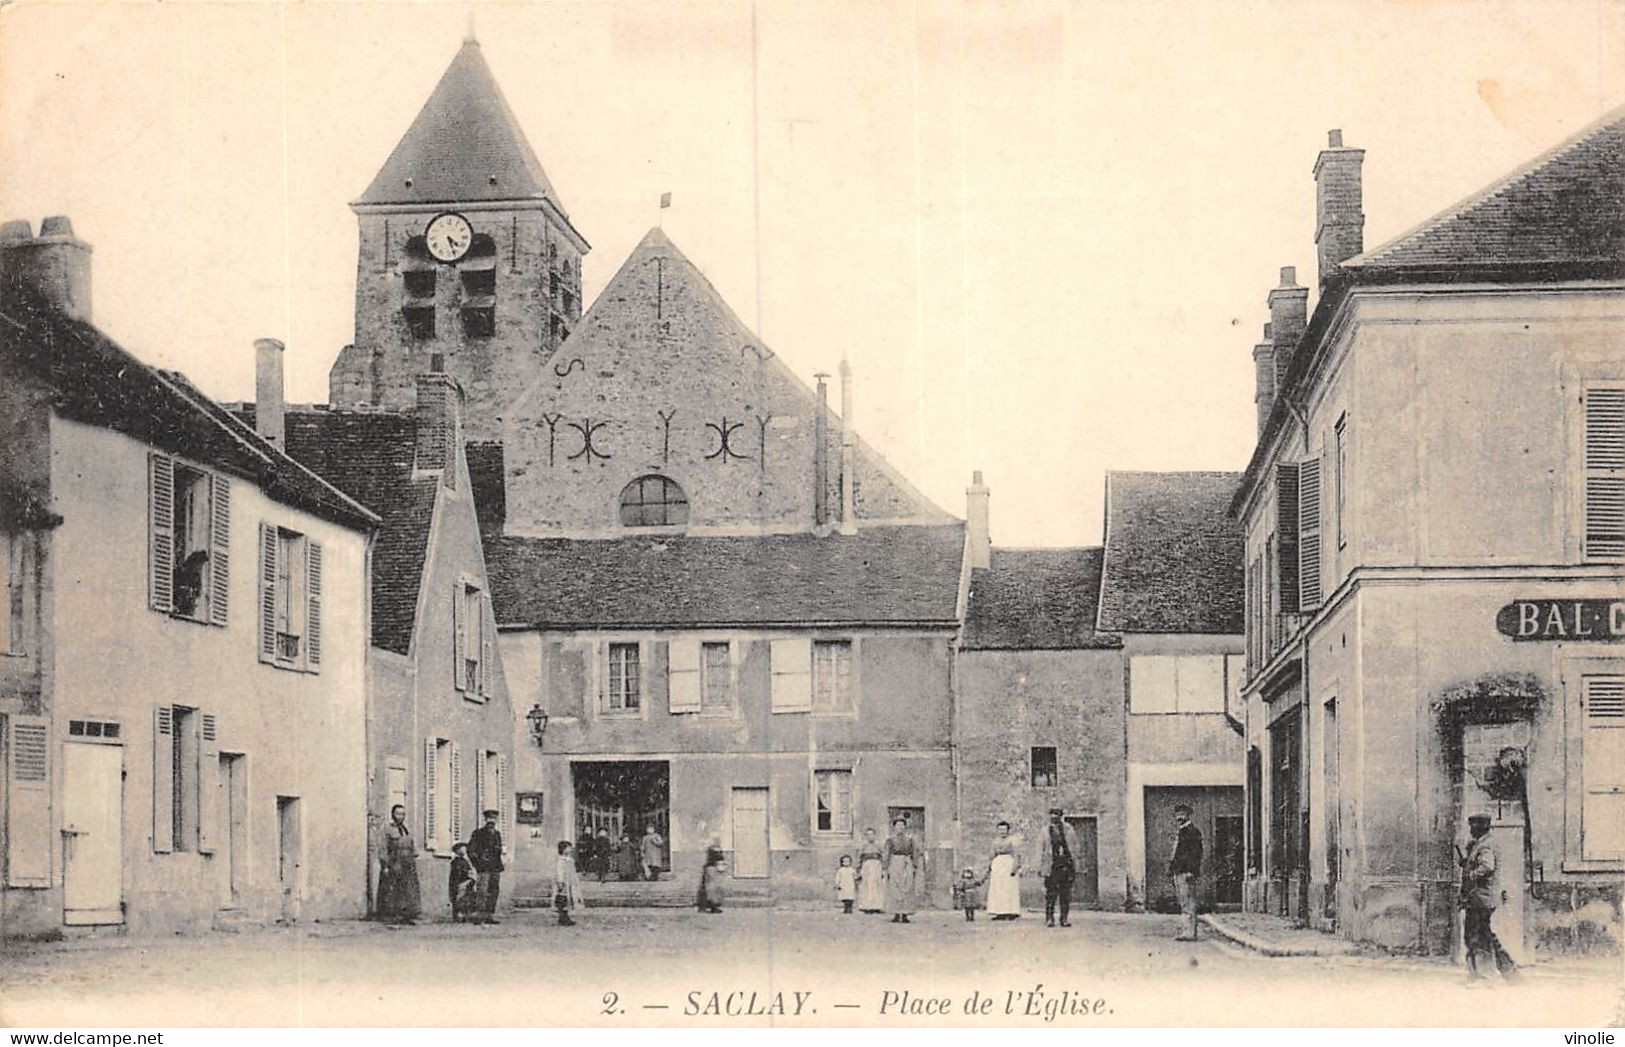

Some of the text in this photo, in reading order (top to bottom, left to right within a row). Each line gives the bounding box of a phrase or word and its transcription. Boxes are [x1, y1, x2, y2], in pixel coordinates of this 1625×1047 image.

[600, 992, 625, 1016] 2.
[684, 991, 817, 1016] SACLAY.
[880, 990, 951, 1015] Place
[964, 991, 993, 1015] de
[1005, 984, 1115, 1022] l'Église.
